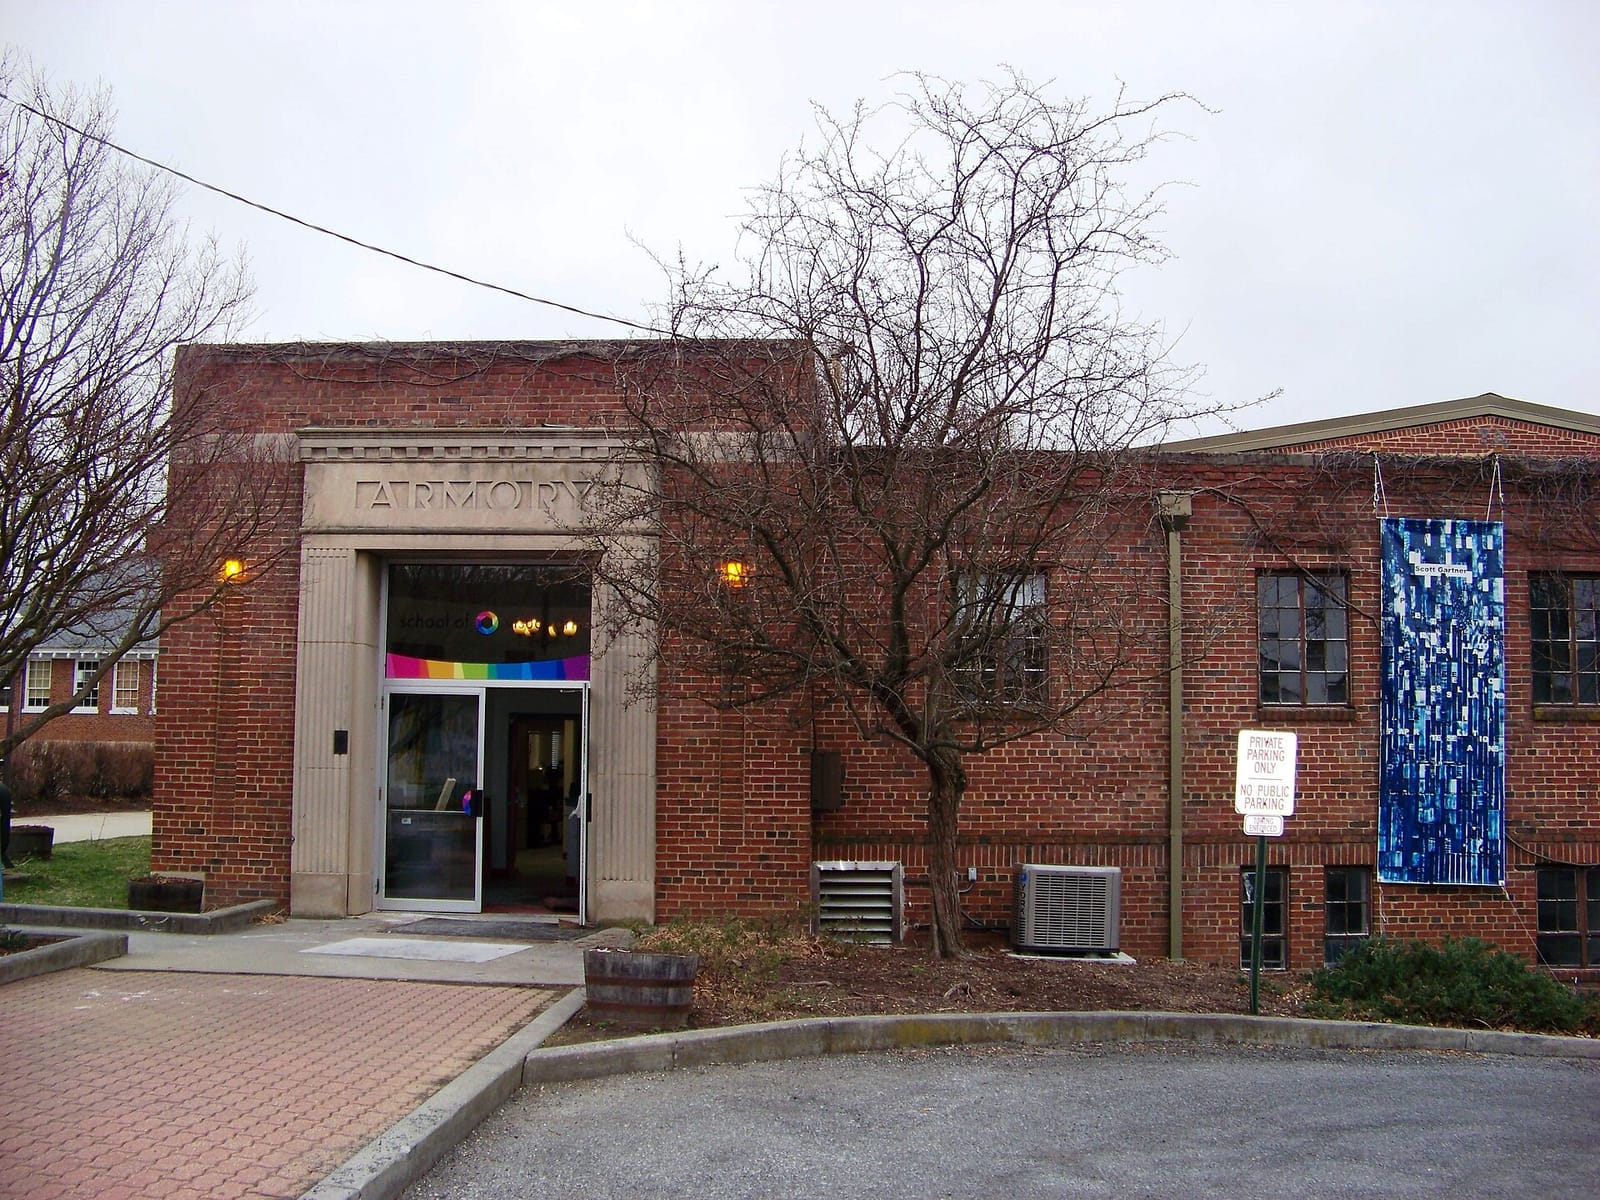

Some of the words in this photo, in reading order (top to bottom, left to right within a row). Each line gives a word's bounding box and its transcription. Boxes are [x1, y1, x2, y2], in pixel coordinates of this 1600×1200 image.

[355, 480, 596, 510] ARMORY
[1415, 565, 1436, 573] Scott
[1437, 566, 1467, 574] Gartner
[399, 612, 449, 630] school
[455, 612, 470, 630] of
[1249, 736, 1284, 749] PRIVATE
[1247, 749, 1285, 761] PARKING
[1254, 761, 1276, 774] ONLY
[1240, 784, 1253, 796] NO
[1257, 785, 1290, 798] PUBLIC
[1244, 797, 1285, 810] PARKING
